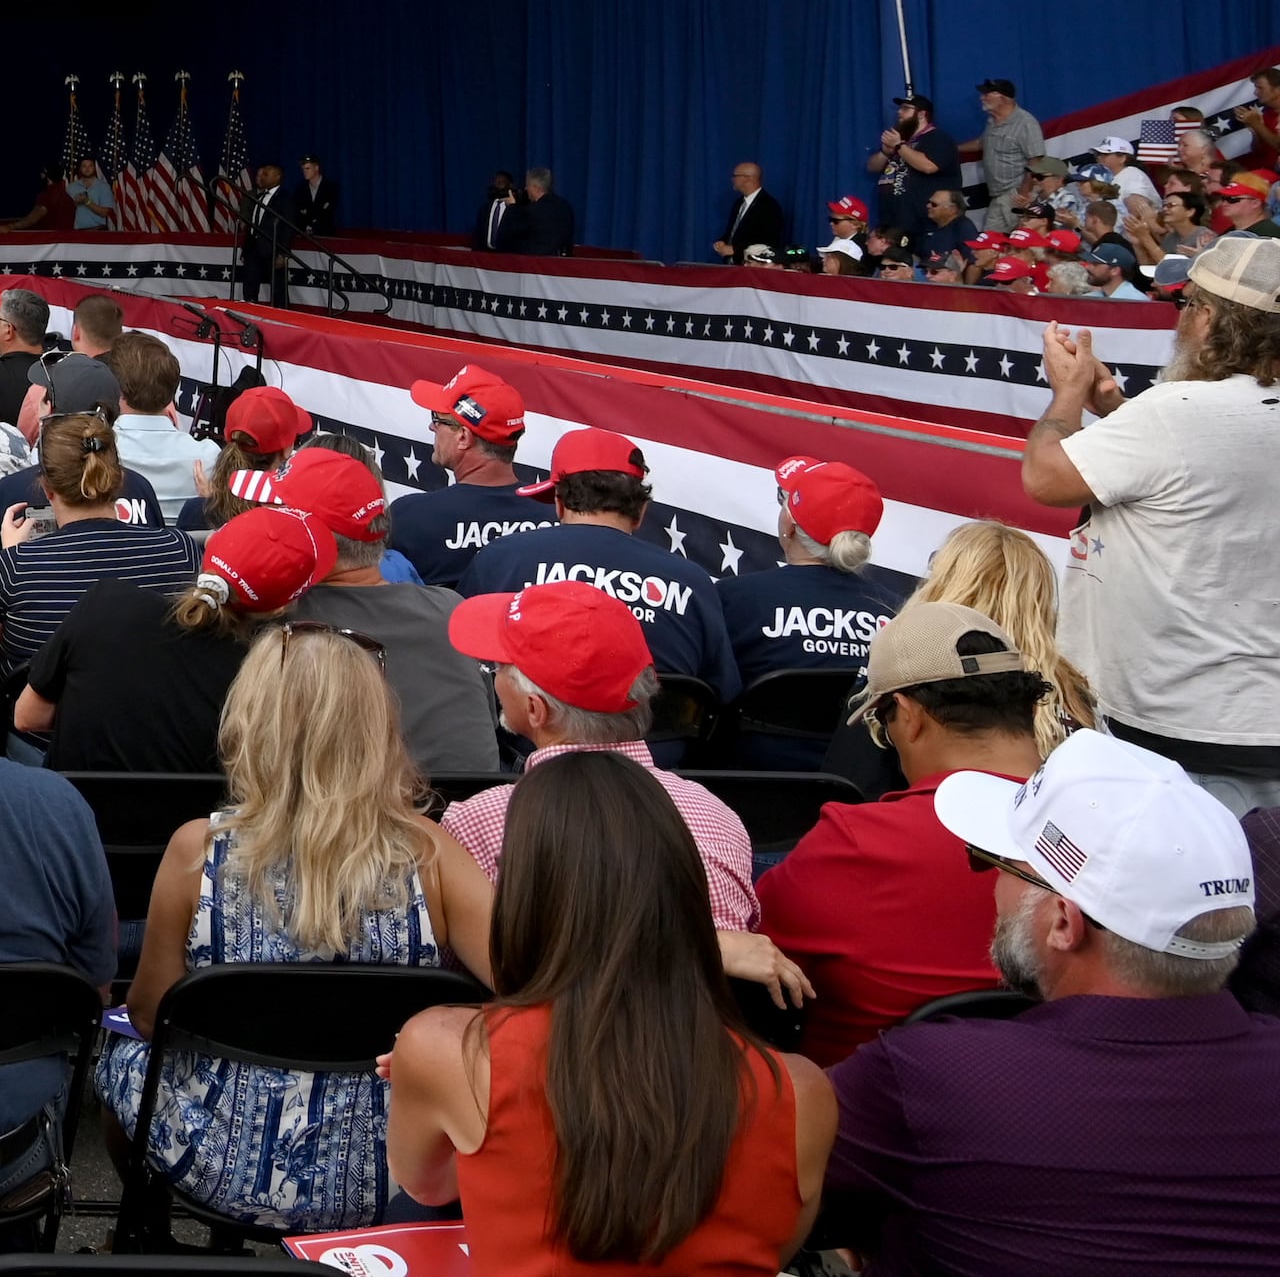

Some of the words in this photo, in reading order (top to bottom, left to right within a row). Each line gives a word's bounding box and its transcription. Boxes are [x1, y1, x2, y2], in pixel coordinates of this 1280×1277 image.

[352, 507, 367, 520] THE
[211, 555, 238, 579] DONALD
[238, 579, 259, 601] TRUMP
[802, 639, 870, 658] GOVERN
[1200, 878, 1250, 897] TRUMP
